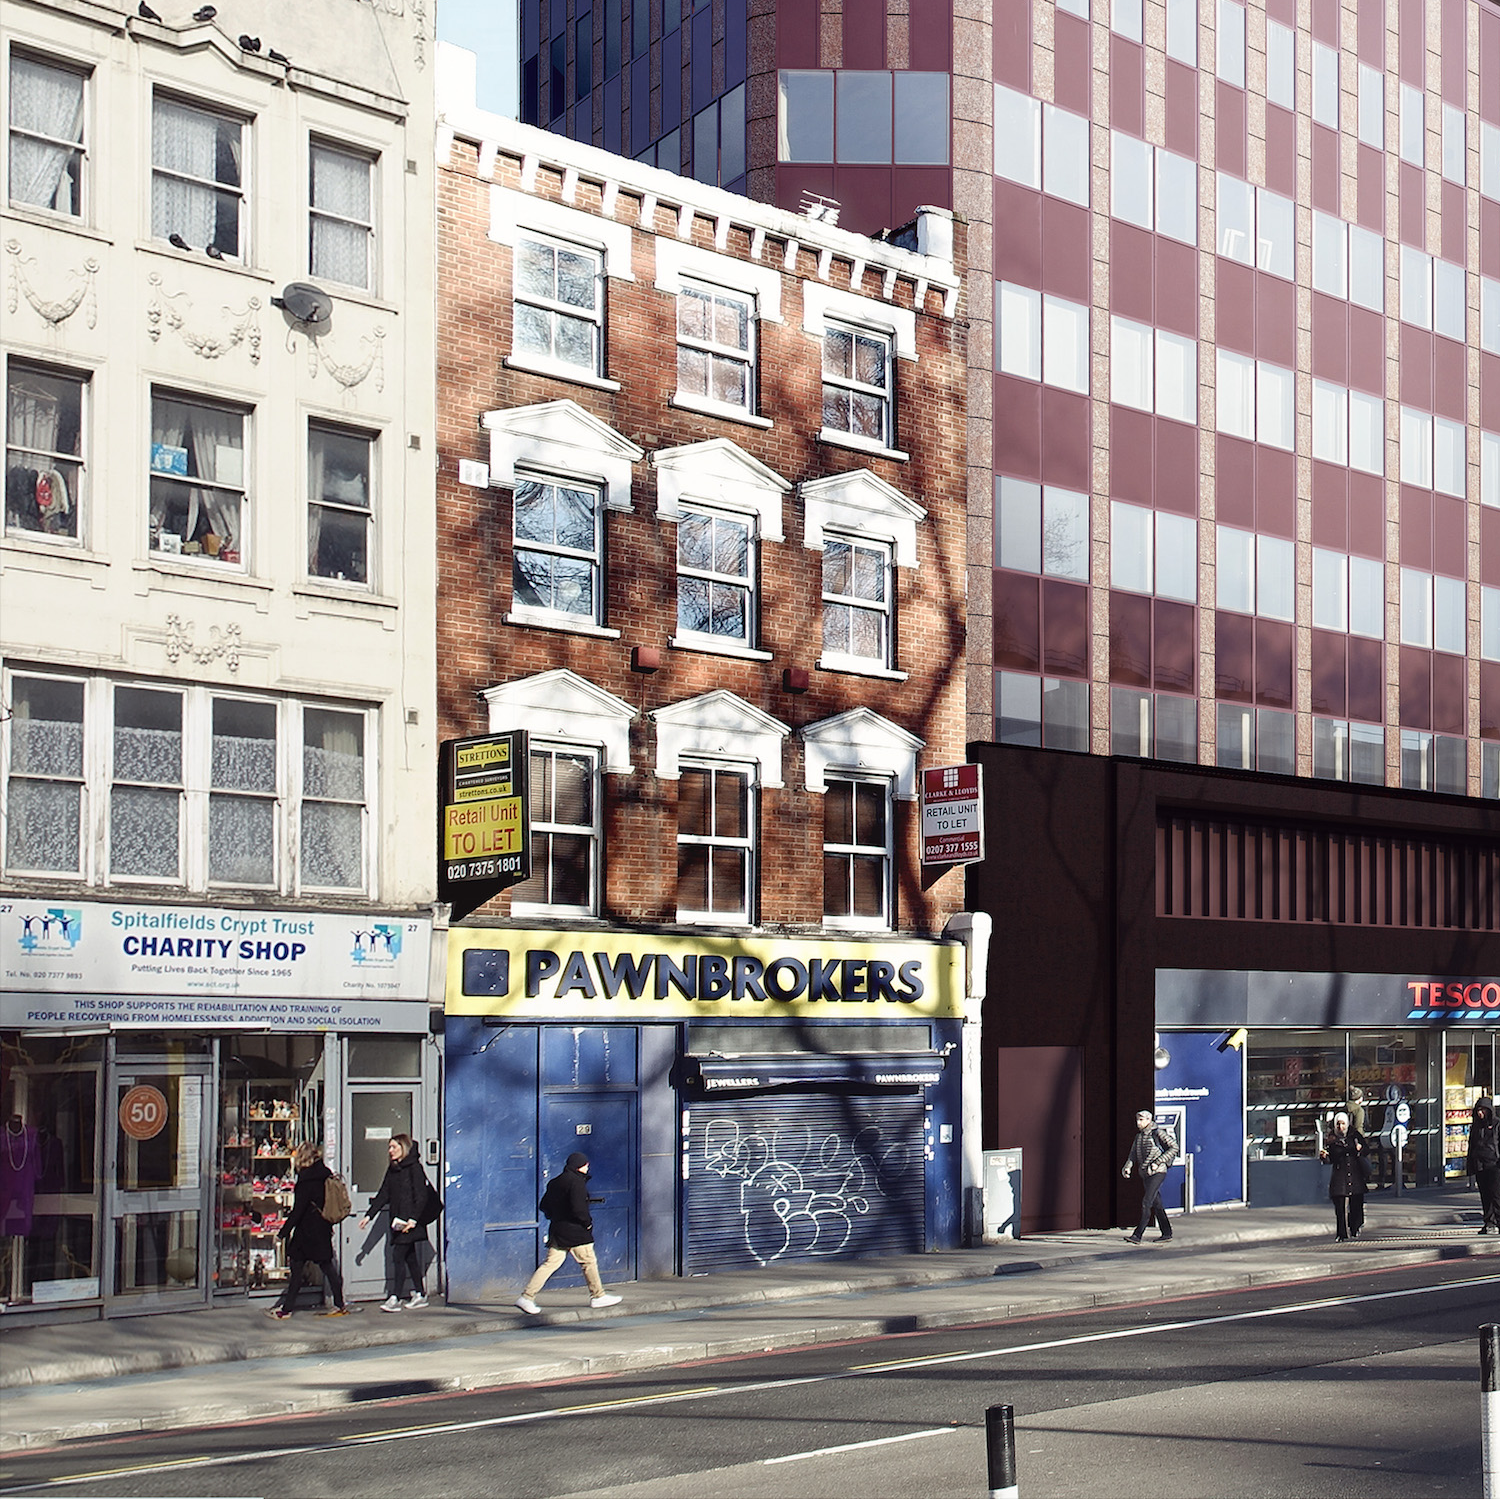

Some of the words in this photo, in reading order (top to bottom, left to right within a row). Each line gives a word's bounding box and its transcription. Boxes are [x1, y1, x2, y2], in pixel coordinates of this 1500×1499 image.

[459, 747, 508, 764] STRETTONS
[459, 785, 507, 798] strettons.co.uk
[925, 790, 948, 799] CLARKE
[954, 787, 978, 795] LLOYDS
[449, 806, 486, 827] Retail
[490, 803, 518, 821] Unit
[926, 806, 955, 817] RETAIL
[958, 804, 977, 814] UNIT
[937, 821, 949, 830] TO
[951, 819, 967, 829] LET
[452, 832, 476, 854] TO
[482, 828, 515, 852] LET
[926, 845, 944, 855] 0207
[945, 843, 959, 853] 377
[961, 841, 978, 851] 1555
[447, 864, 467, 880] 020
[468, 860, 494, 877] 7375
[496, 856, 521, 872] 1801
[0, 905, 13, 913] 27
[111, 910, 216, 931] Spitalfields
[220, 916, 268, 936] Crypt
[272, 918, 315, 935] Trust
[407, 924, 418, 932] 27
[122, 936, 232, 959] CHARITY
[239, 940, 307, 961] SHOP
[131, 964, 163, 974] Putting
[164, 965, 185, 974] Lives
[187, 966, 208, 975] Back
[210, 966, 245, 976] Together
[247, 967, 269, 976] Since
[271, 968, 292, 977] 1965
[524, 950, 924, 1002] PAWNBROKERS
[74, 1000, 96, 1009] THIS
[98, 1000, 124, 1009] SHOP
[126, 1001, 176, 1010] SUPPORTS
[178, 1002, 195, 1011] THE
[197, 1002, 268, 1012] REHABILITATION
[269, 1004, 288, 1012] AND
[290, 1004, 329, 1014] TRAINING
[331, 1005, 343, 1013] OF
[27, 1011, 66, 1020] PEOPLE
[68, 1012, 129, 1021] RECOVERING
[131, 1013, 159, 1021] FROM
[287, 1016, 305, 1024] AND
[307, 1016, 337, 1025] SOCIAL
[339, 1017, 381, 1026] ISOLATION
[705, 1077, 760, 1090] JEWELLERS
[875, 1072, 940, 1083] PAWNBROKERS
[131, 1103, 157, 1122] 50
